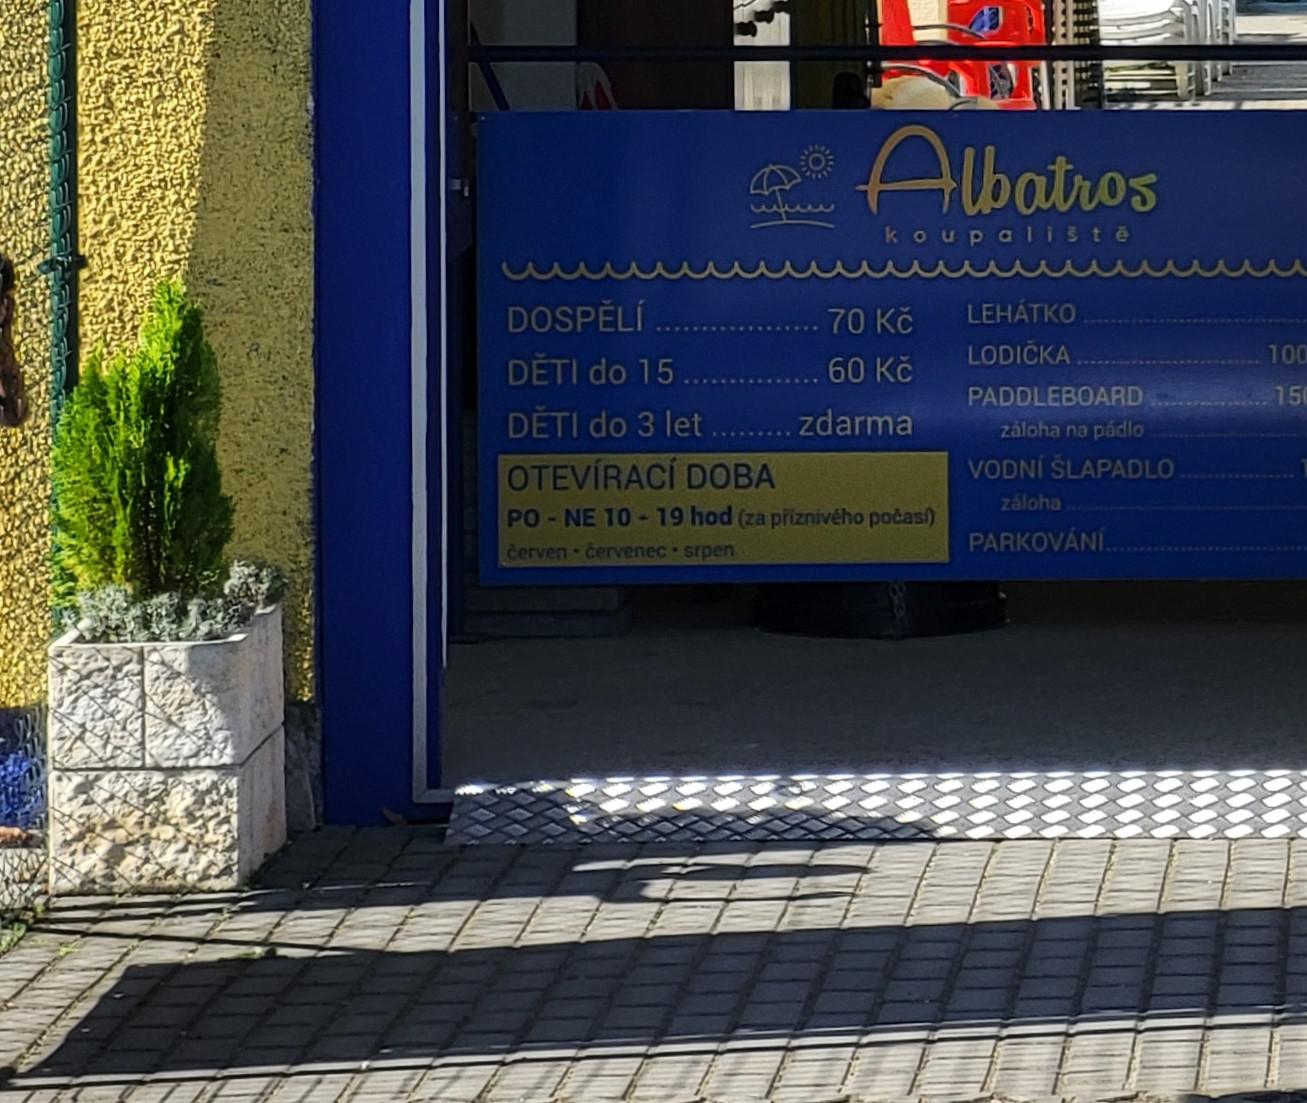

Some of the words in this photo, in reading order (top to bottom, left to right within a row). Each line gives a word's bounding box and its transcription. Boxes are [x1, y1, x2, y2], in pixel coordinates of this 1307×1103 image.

[855, 124, 1157, 216] Albatros
[885, 225, 1131, 247] koupaliště
[507, 300, 645, 333] DOSPĚLÍ
[828, 309, 865, 334] 70
[876, 307, 914, 334] Kč
[967, 300, 1077, 325] LEHÁTKO
[967, 340, 1071, 366] LODIČKA
[507, 356, 578, 386] DĚTI
[588, 358, 627, 386] do
[639, 358, 674, 385] 15
[828, 357, 865, 383] 60
[876, 355, 914, 383] Kč
[967, 385, 1144, 407] PADDLEBOARD
[507, 408, 578, 439] DĚTI
[588, 411, 627, 438] do
[637, 411, 655, 438] 3
[665, 410, 703, 438] let
[798, 409, 914, 437] zdarma
[1000, 420, 1060, 439] záloha
[1065, 425, 1089, 439] na
[1094, 419, 1145, 442] pádlo
[507, 457, 677, 492] OTEVÍRACÍ
[686, 462, 776, 490] DOBA
[968, 454, 1045, 480] VODNÍ
[1051, 454, 1175, 480] ŠLAPADLO
[1000, 494, 1062, 512] záloha
[507, 508, 541, 528] PO
[564, 508, 596, 528] NE
[604, 508, 633, 528] 10
[656, 507, 685, 528] 19
[689, 505, 733, 527] hod
[738, 507, 766, 530] (za
[770, 504, 865, 529] příznivého
[868, 504, 936, 529] počasí)
[506, 540, 568, 560] červen
[585, 540, 667, 560] červenec
[683, 544, 736, 563] srpen
[969, 526, 1105, 553] PARKOVÁNÍ
